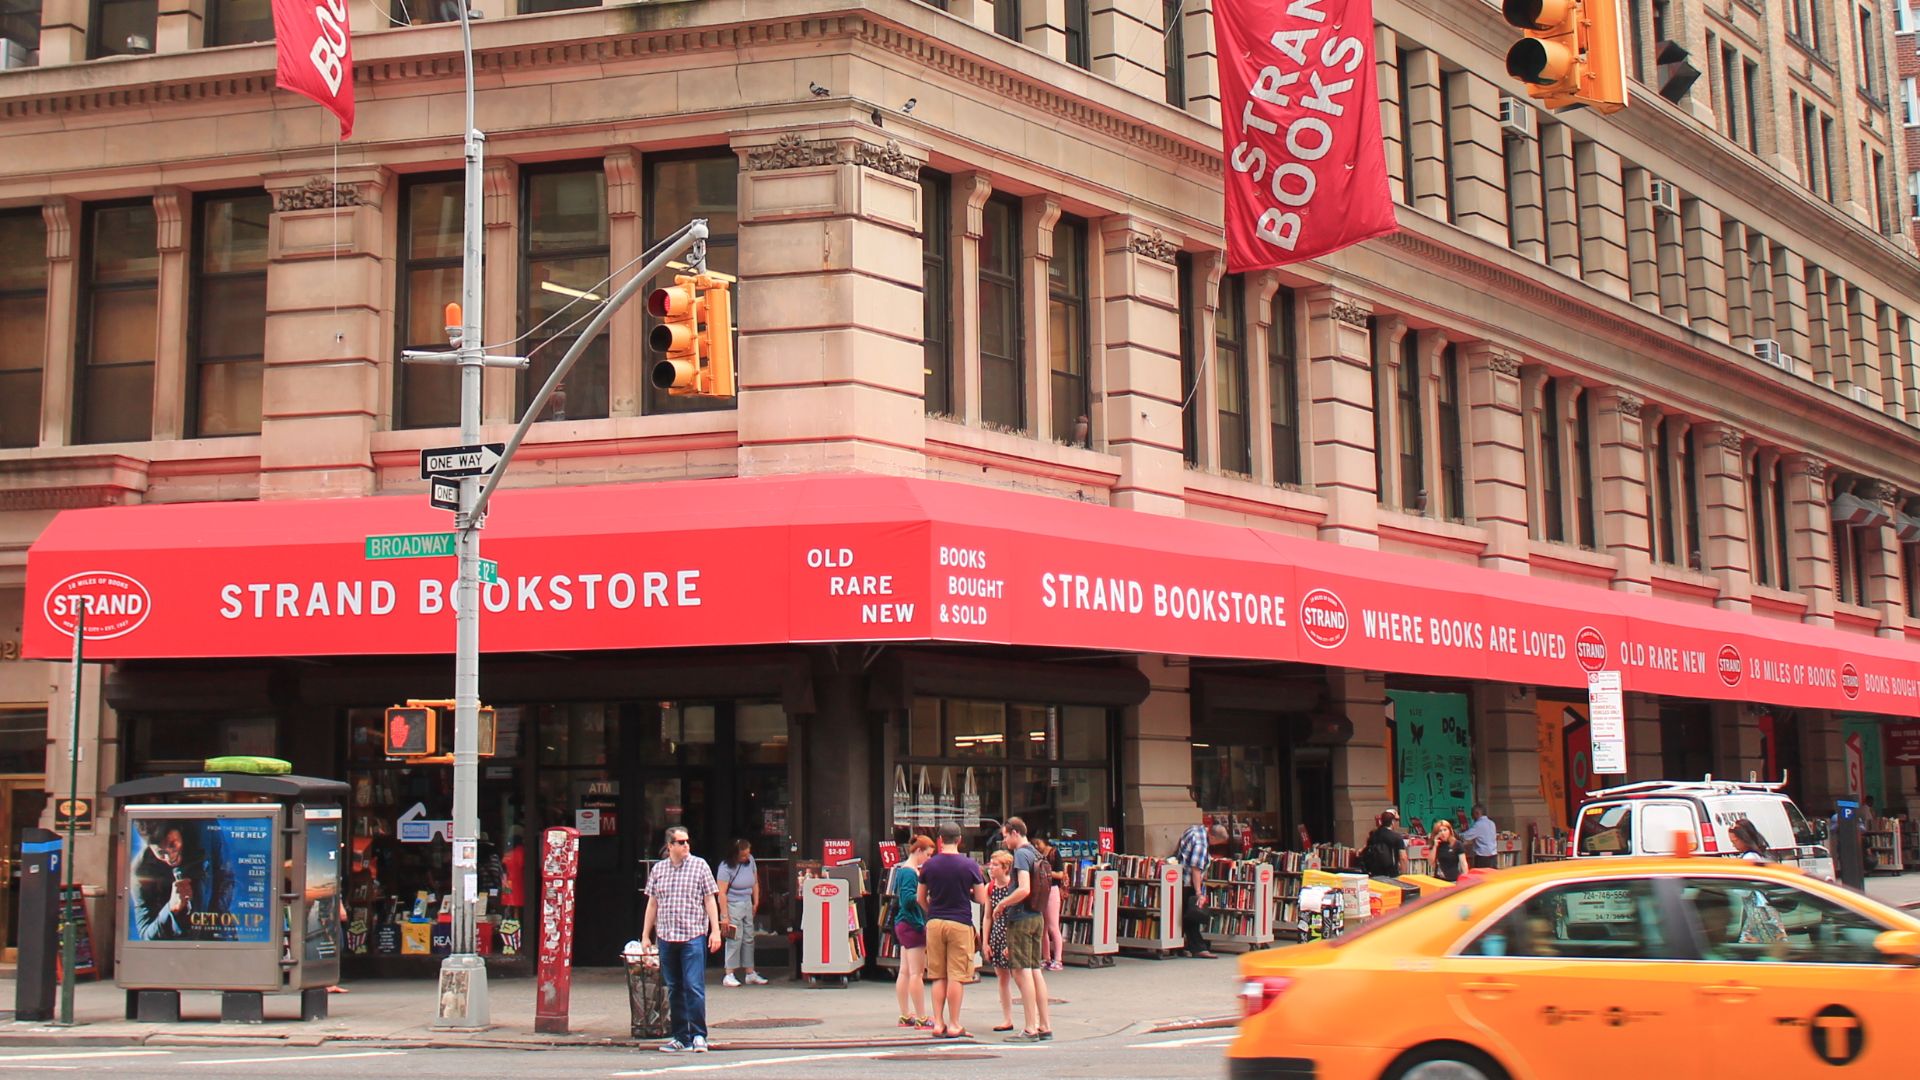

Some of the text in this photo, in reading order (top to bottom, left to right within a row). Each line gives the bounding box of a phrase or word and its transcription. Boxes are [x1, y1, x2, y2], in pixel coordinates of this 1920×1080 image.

[1256, 36, 1364, 251] BOOKS
[430, 454, 482, 470] ONE WAY
[437, 486, 453, 501] ONE
[371, 535, 450, 556] BROADWAY
[807, 548, 854, 568] OLD
[939, 546, 986, 570] BOOKS
[483, 562, 490, 581] 12
[78, 578, 97, 587] MILES
[108, 578, 129, 590] BOOKS
[830, 575, 893, 596] RARE
[949, 576, 1004, 599] BOUGHT
[53, 593, 143, 616] STRAND
[219, 580, 396, 619] STRAND
[1042, 572, 1287, 627] STRAND BOOKSTORE
[862, 603, 915, 624] NEW
[939, 603, 987, 625] & SOLD
[1305, 606, 1345, 629] STRAND
[1362, 608, 1566, 660] WHERE BOOKS ARE LOVED
[1578, 642, 1605, 659] STRAND
[1620, 641, 1706, 674] OLD RARE NEW
[1719, 658, 1740, 673] STRAND
[1749, 657, 1837, 688] 18 MILES OF BOOKS
[1865, 672, 1890, 695] BOOKS
[187, 778, 218, 787] TITAN
[589, 782, 611, 793] ATM
[1844, 808, 1852, 818] P
[231, 831, 267, 839] THE HELP
[1102, 837, 1111, 850] $2
[50, 854, 58, 871] P
[190, 912, 264, 927] GET ON UP
